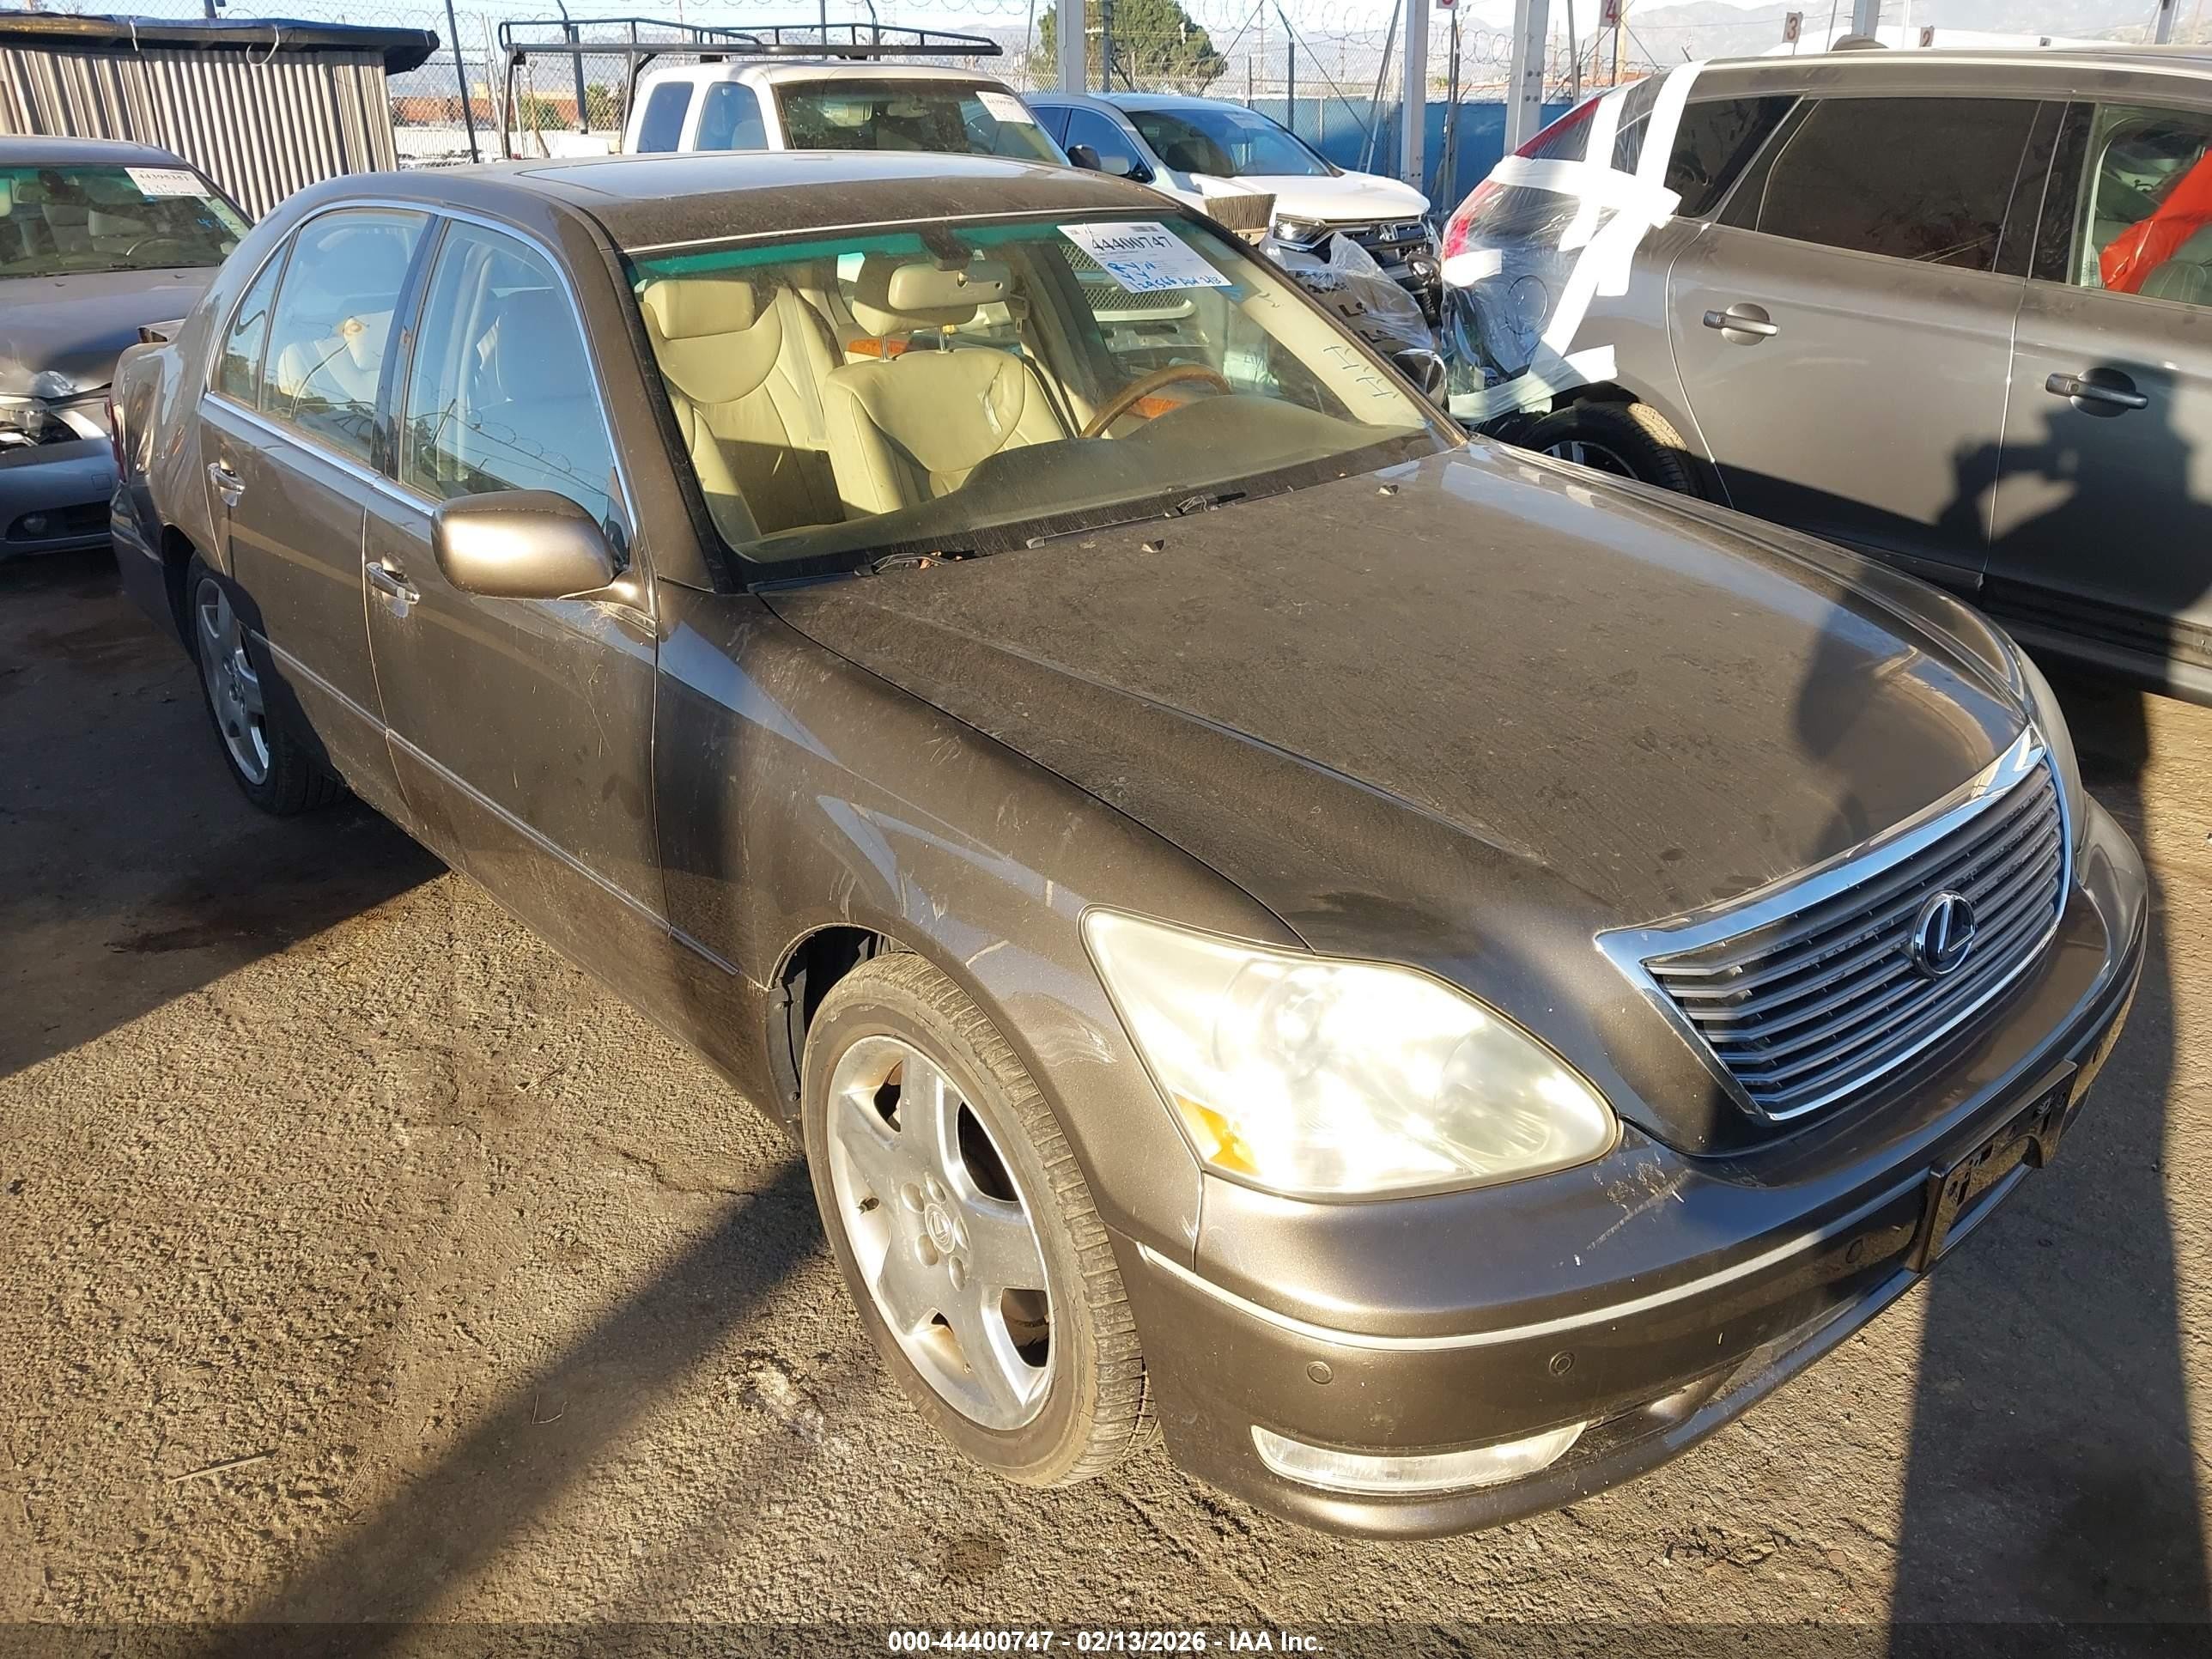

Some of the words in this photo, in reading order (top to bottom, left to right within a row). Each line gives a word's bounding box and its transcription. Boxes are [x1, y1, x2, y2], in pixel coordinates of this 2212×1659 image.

[1606, 0, 1619, 24] 4
[1787, 16, 1799, 40] 3
[1923, 30, 1931, 47] 2
[1091, 236, 1174, 252] 44400747
